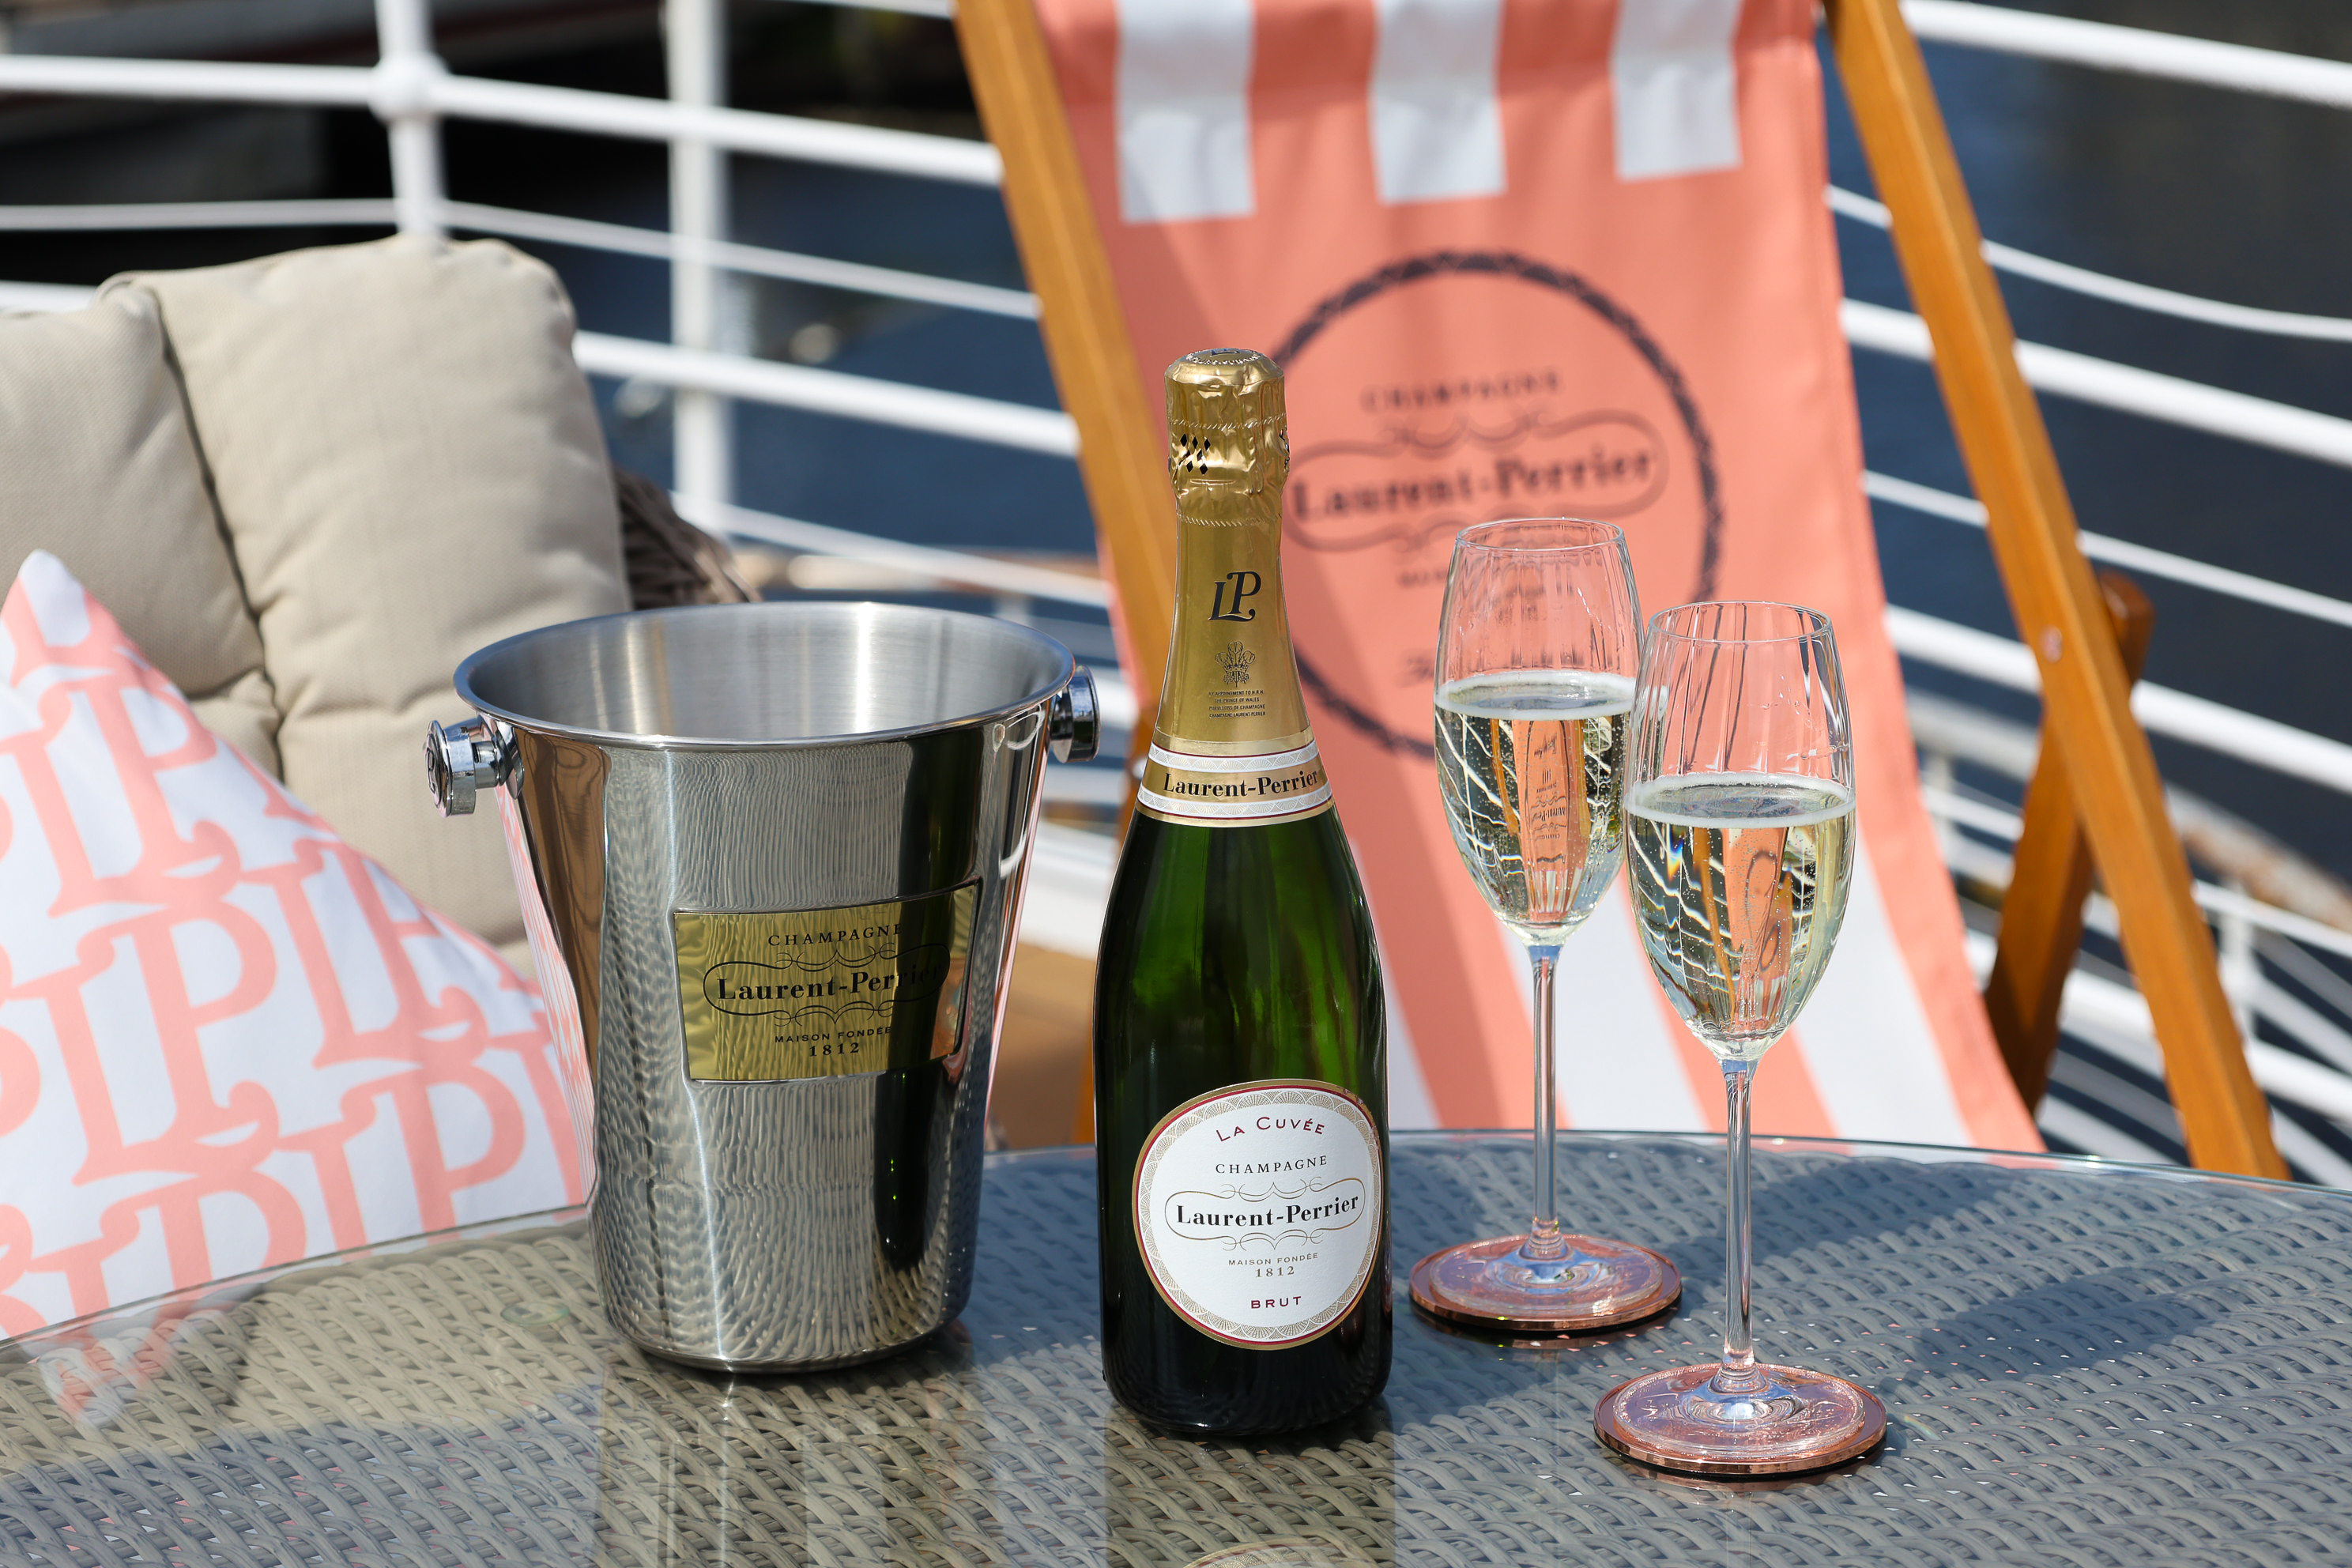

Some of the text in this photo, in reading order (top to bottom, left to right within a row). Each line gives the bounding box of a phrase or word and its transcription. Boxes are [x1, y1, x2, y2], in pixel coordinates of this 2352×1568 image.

[1292, 444, 1653, 522] Laurent-Perrier
[1208, 571, 1261, 622] LP
[1163, 771, 1318, 797] Laurent-Perrier
[768, 923, 903, 947] CHAMPAGNE
[716, 963, 942, 1001] Laurent-Perrier
[775, 1026, 891, 1043] MAISON FONDÉE
[809, 1042, 859, 1057] 1812
[1215, 1155, 1328, 1174] CHAMPAGNE
[1175, 1195, 1359, 1226] Laurent-Perrier
[1276, 1252, 1318, 1264] FONDÉE
[1254, 1265, 1295, 1278] 1812
[1250, 1295, 1302, 1310] BRUT
